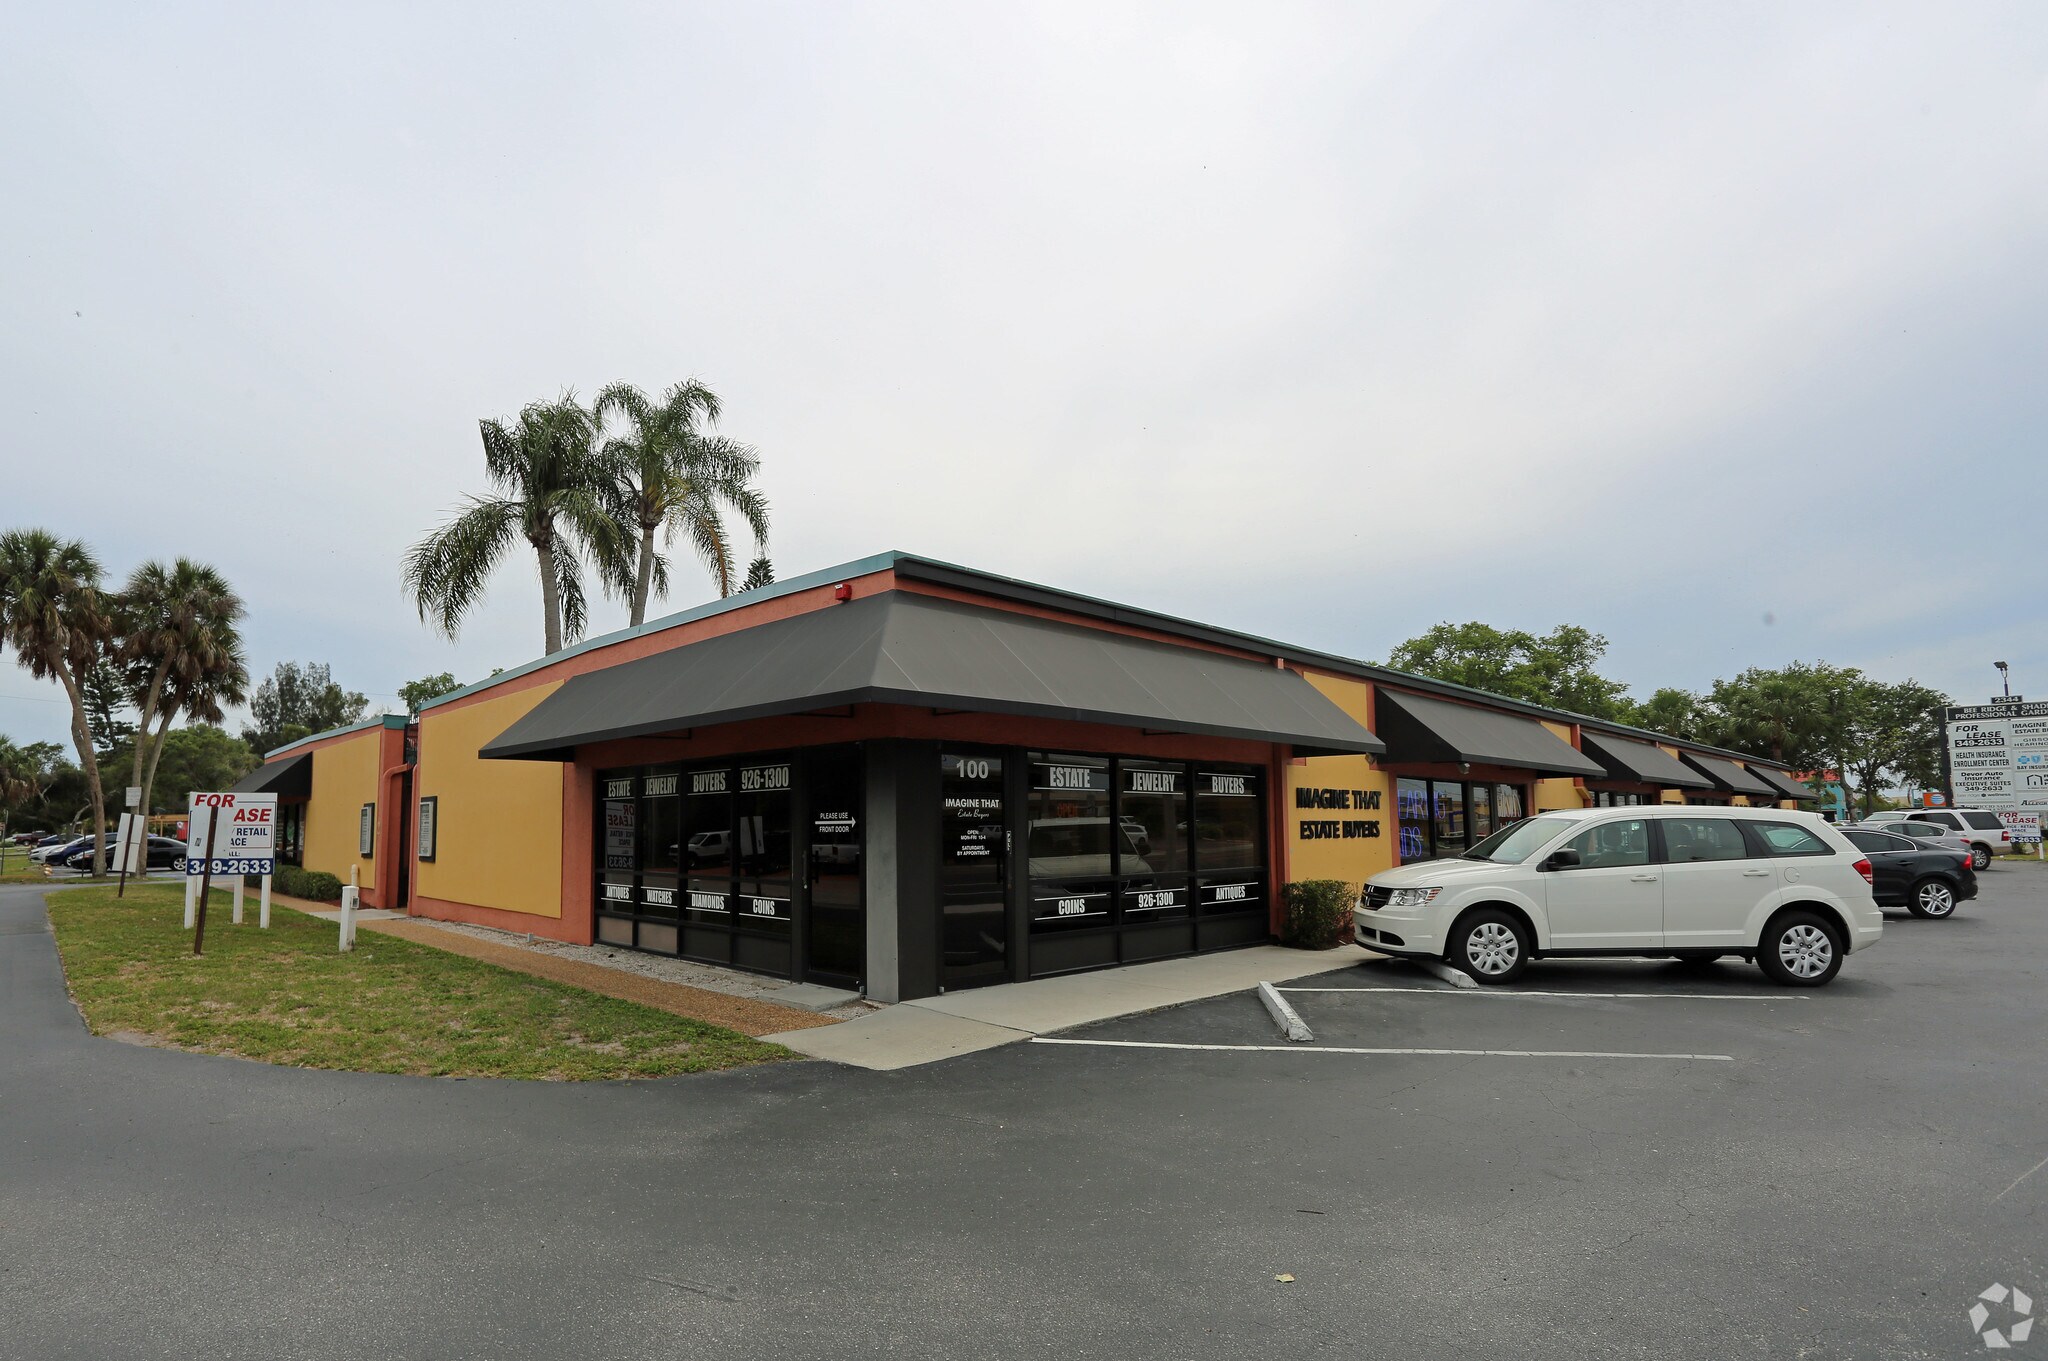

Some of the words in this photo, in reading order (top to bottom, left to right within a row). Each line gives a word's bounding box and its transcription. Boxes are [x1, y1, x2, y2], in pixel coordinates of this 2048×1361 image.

[1994, 696, 2019, 704] 2344
[1955, 710, 2017, 719] PROFESSIONAL
[2020, 708, 2048, 716] GARD
[1981, 705, 2007, 713] RIDGE
[1956, 739, 2003, 747] 349-2633
[1966, 731, 2001, 739] LEASE
[1976, 751, 2006, 759] INSURANCE
[956, 759, 989, 779] 100
[1954, 760, 1988, 768] ENROLLMENT
[1990, 759, 2010, 767] CENTER
[693, 772, 726, 793] BUYERS
[741, 766, 790, 790] 926-1300
[1050, 767, 1091, 788] ESTATE
[1132, 772, 1175, 792] JEWELRY
[1212, 776, 1245, 795] BUYERS
[608, 780, 631, 798] ESTATE
[646, 776, 678, 796] JEWELRY
[194, 794, 236, 808] FOR
[945, 798, 980, 808] IMAGINE
[981, 799, 1000, 808] THAT
[1296, 787, 1350, 809] IMAGINE
[1351, 790, 1382, 810] THAT
[233, 808, 272, 822] ASE
[236, 827, 268, 836] RETAIL
[1300, 820, 1340, 839] ESTATE
[1342, 820, 1380, 838] BUYERS
[606, 885, 629, 900] ANTIQUES
[647, 889, 672, 905] WATCHES
[1138, 891, 1174, 908] 926-1300
[1215, 885, 1246, 901] ANTIQUES
[691, 893, 725, 910] DIAMONDS
[752, 899, 775, 916] COINS
[1058, 900, 1085, 915] COINS
